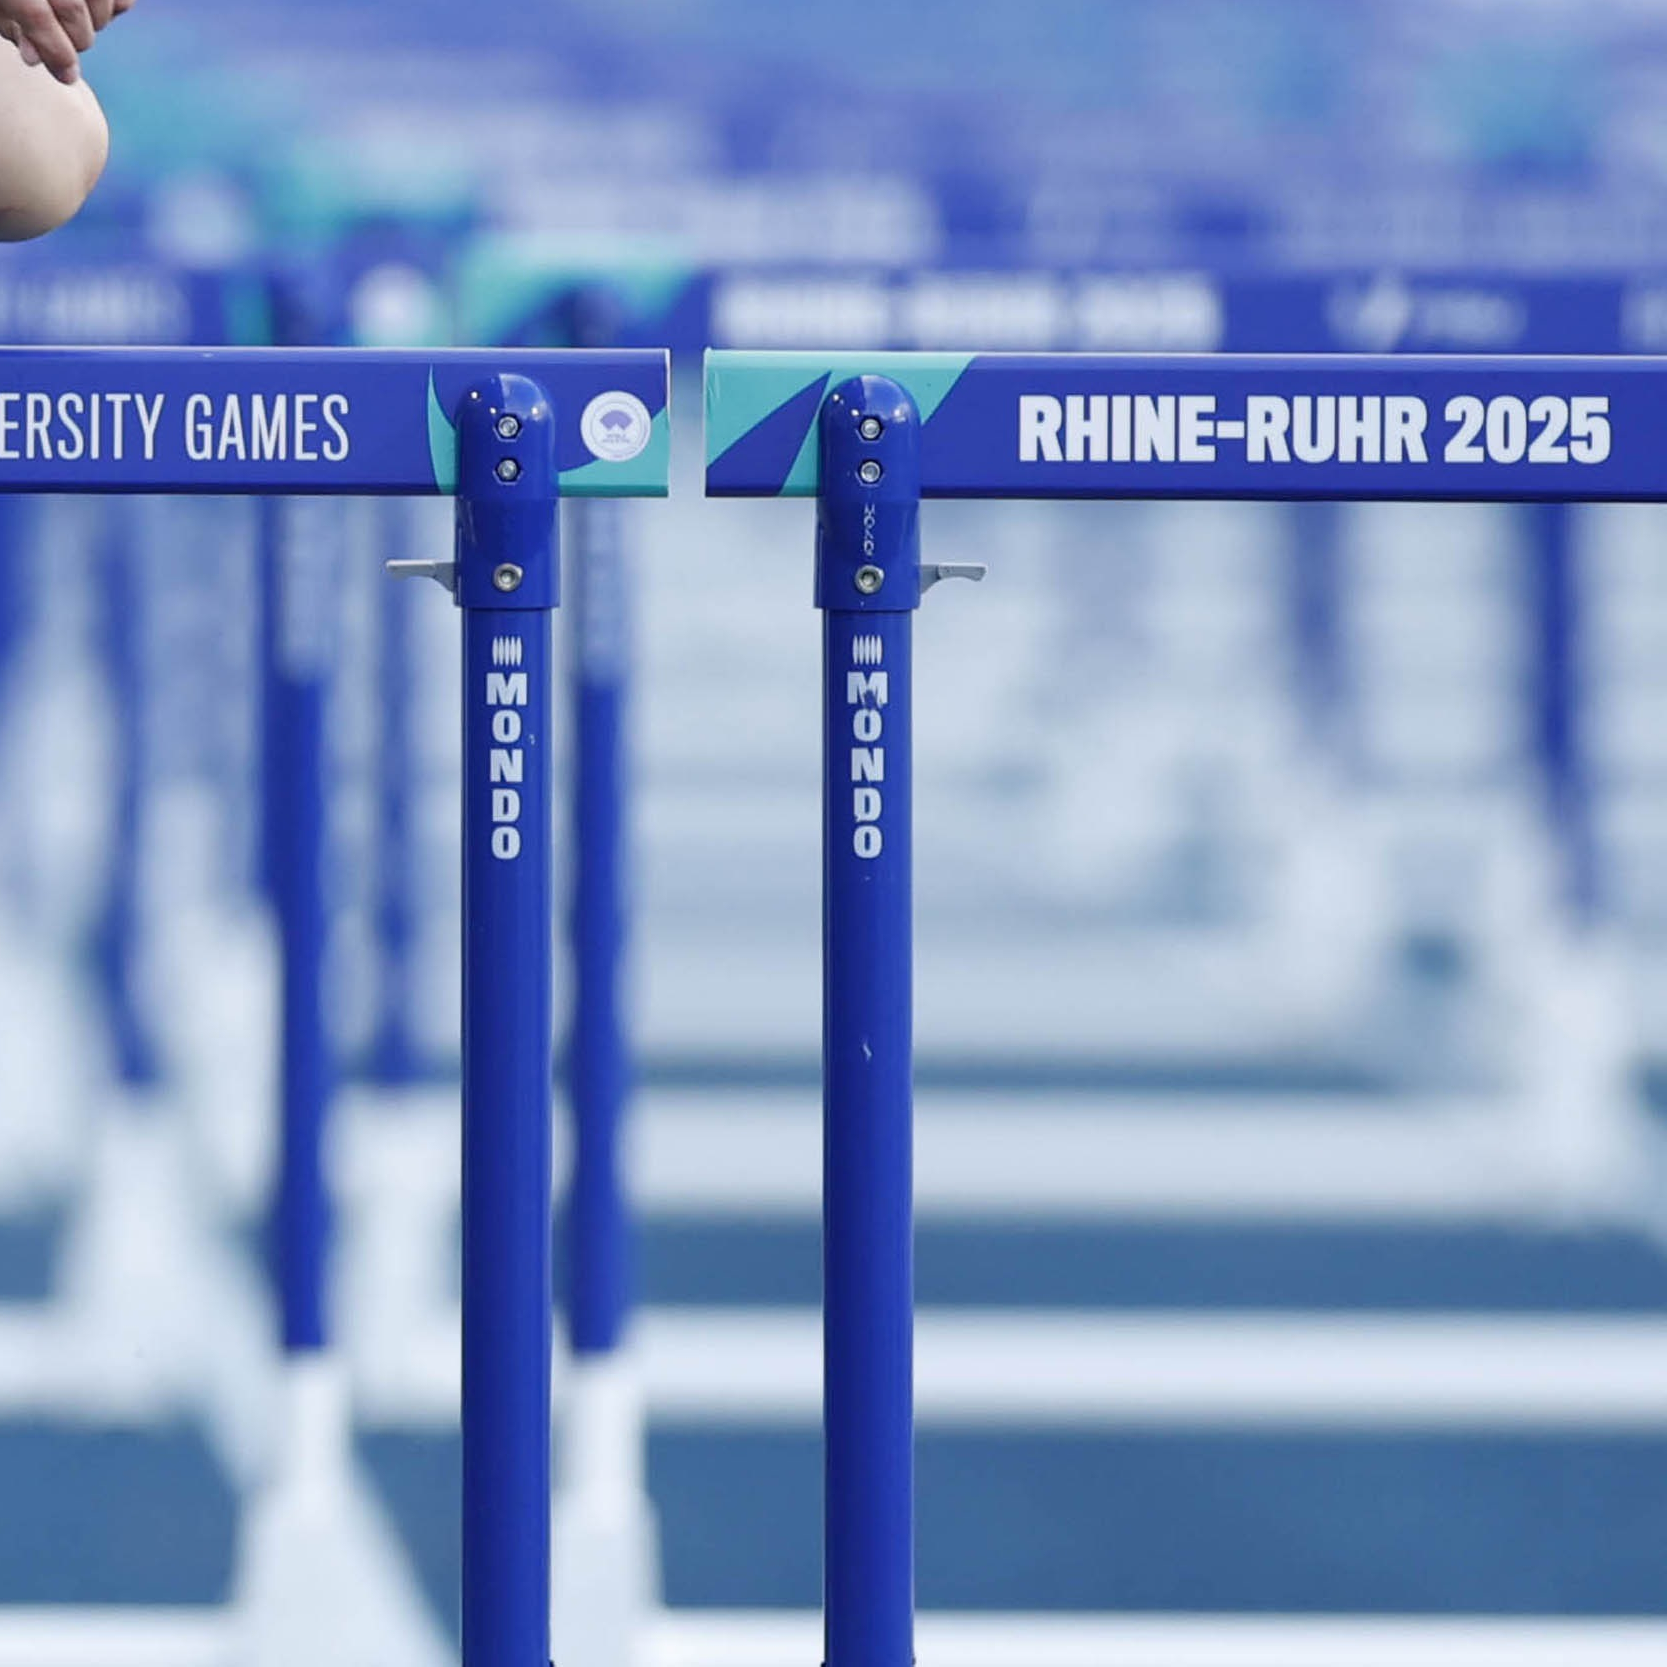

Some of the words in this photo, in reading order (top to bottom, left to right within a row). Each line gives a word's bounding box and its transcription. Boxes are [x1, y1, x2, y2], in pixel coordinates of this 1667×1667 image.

[184, 393, 350, 461] GAMES
[1018, 395, 1429, 463] RHINE-RUHR
[1443, 395, 1612, 464] 2025
[486, 672, 527, 860] MONDO
[847, 670, 889, 859] MONDO
